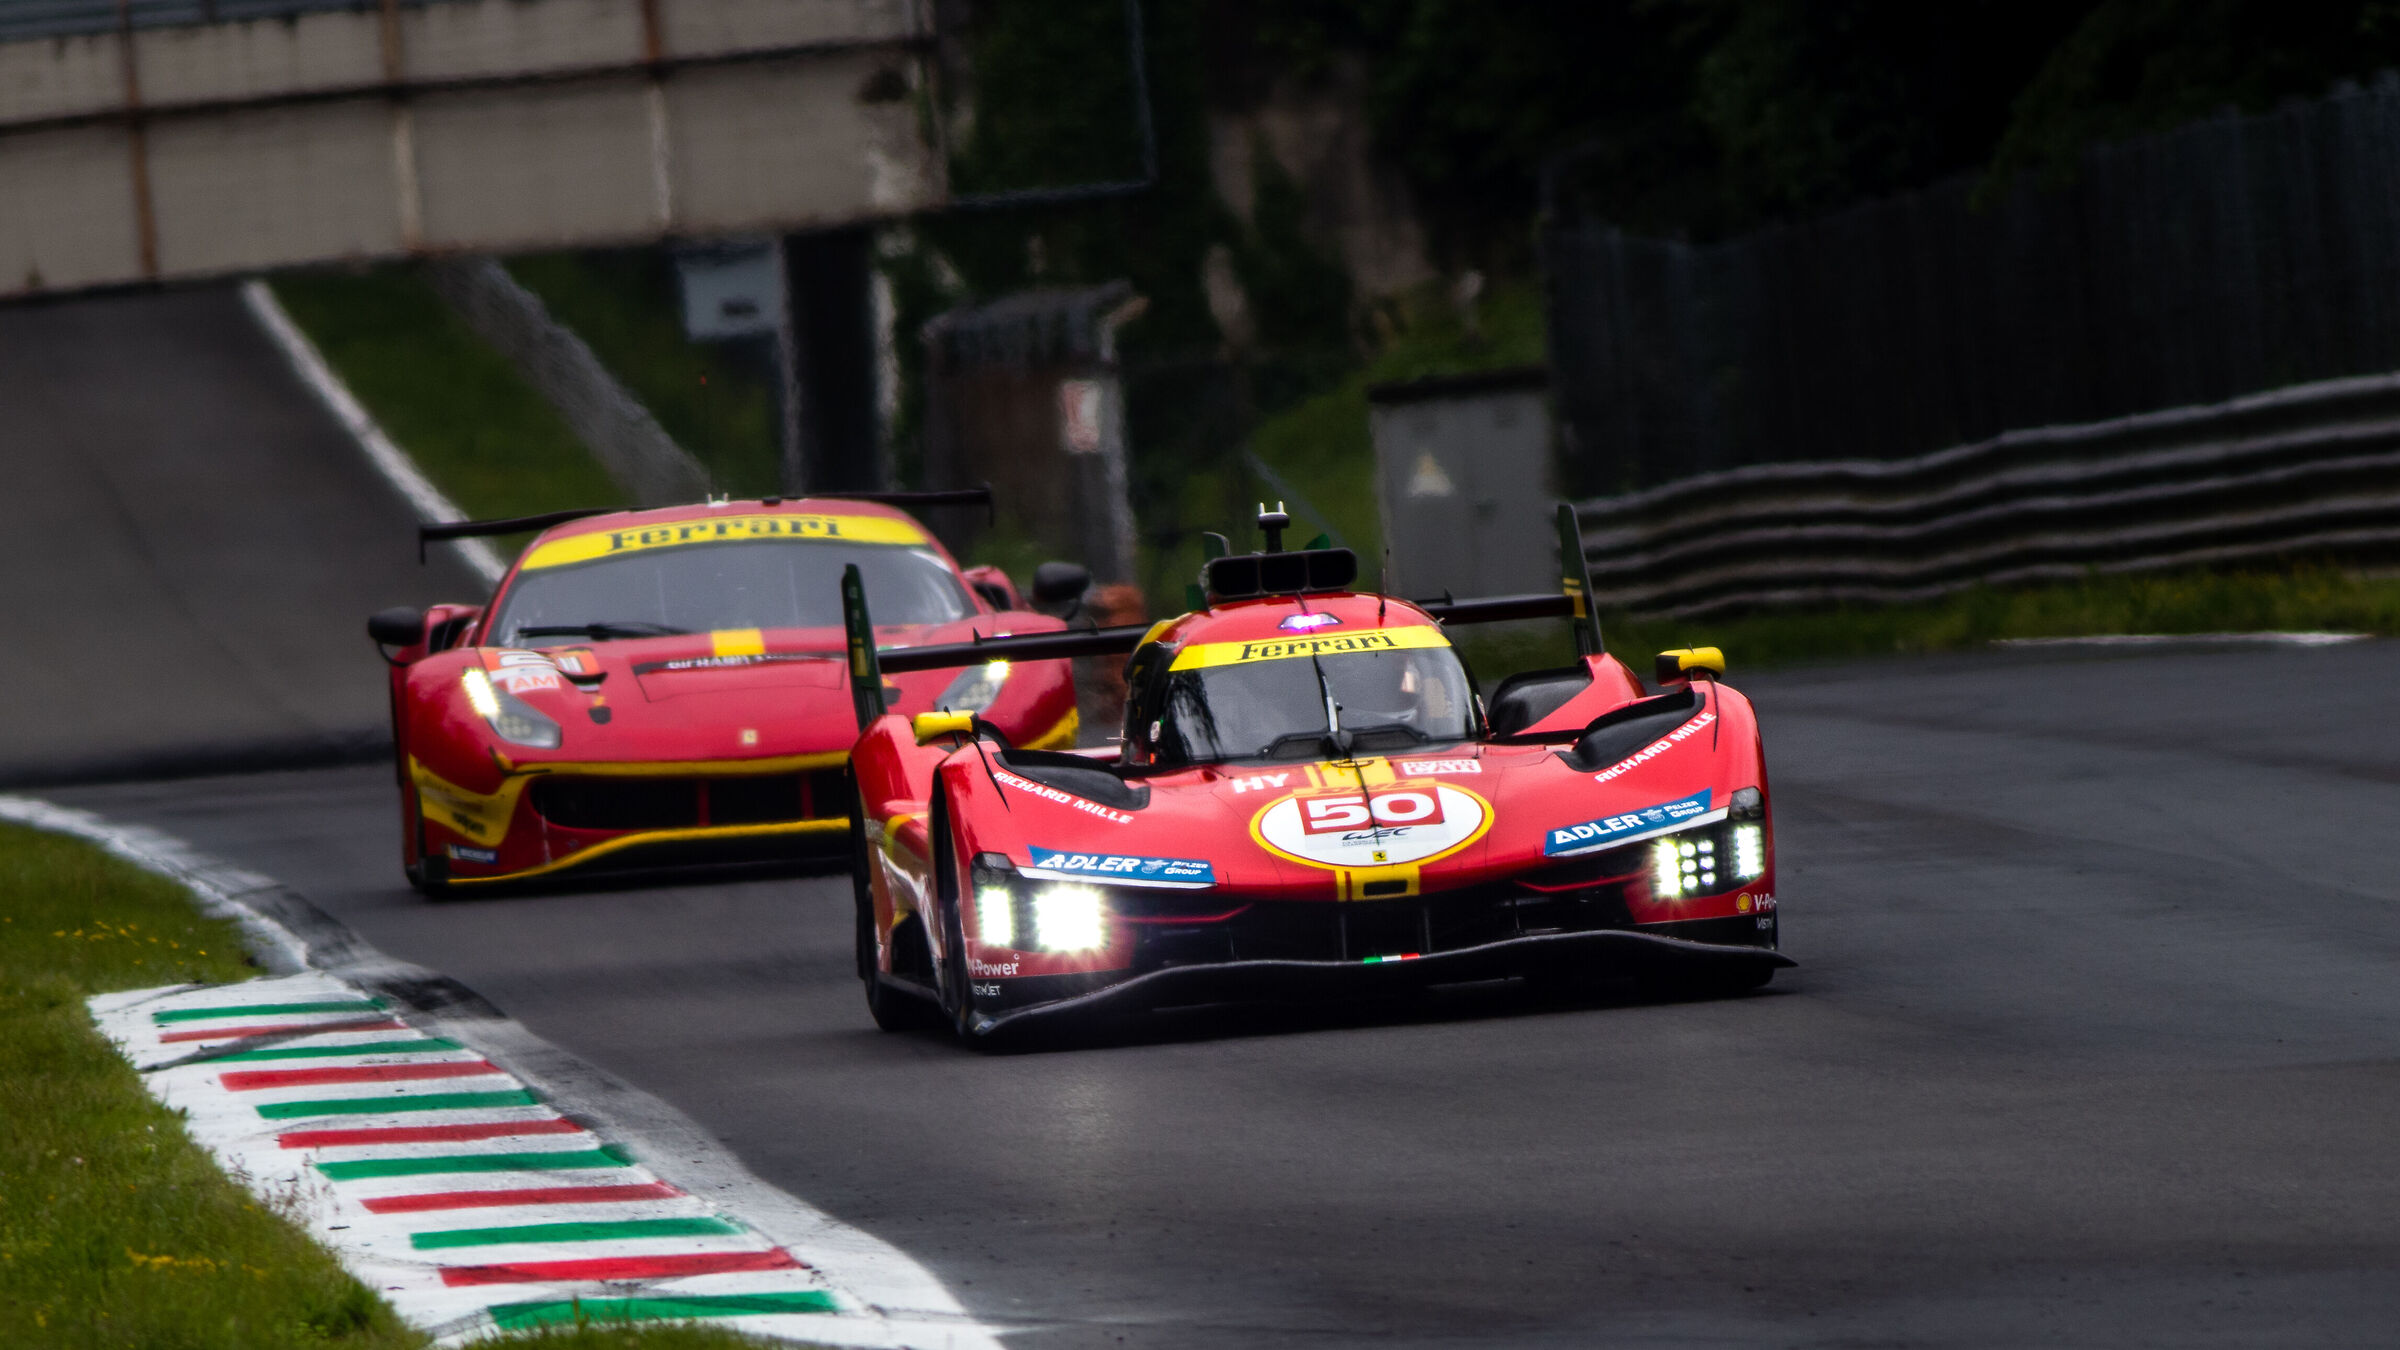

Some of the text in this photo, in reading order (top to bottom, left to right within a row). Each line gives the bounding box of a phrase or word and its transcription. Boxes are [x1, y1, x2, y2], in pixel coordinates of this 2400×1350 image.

[606, 516, 841, 551] Ferrari
[1236, 632, 1398, 660] Ferrari
[513, 675, 556, 690] AM
[1595, 712, 1717, 783] RICHARD MILLE
[1407, 764, 1477, 775] CAR
[1233, 773, 1289, 793] HY
[993, 771, 1134, 824] RICHARD MILLE
[1664, 800, 1699, 813] PELZER
[1306, 792, 1435, 829] 50
[1669, 806, 1705, 818] GROUP
[1342, 826, 1412, 840] WEC
[1554, 814, 1645, 844] ADLER
[1036, 853, 1141, 873] ADLER
[1164, 867, 1202, 876] GROUP
[1171, 860, 1208, 869] PELZER
